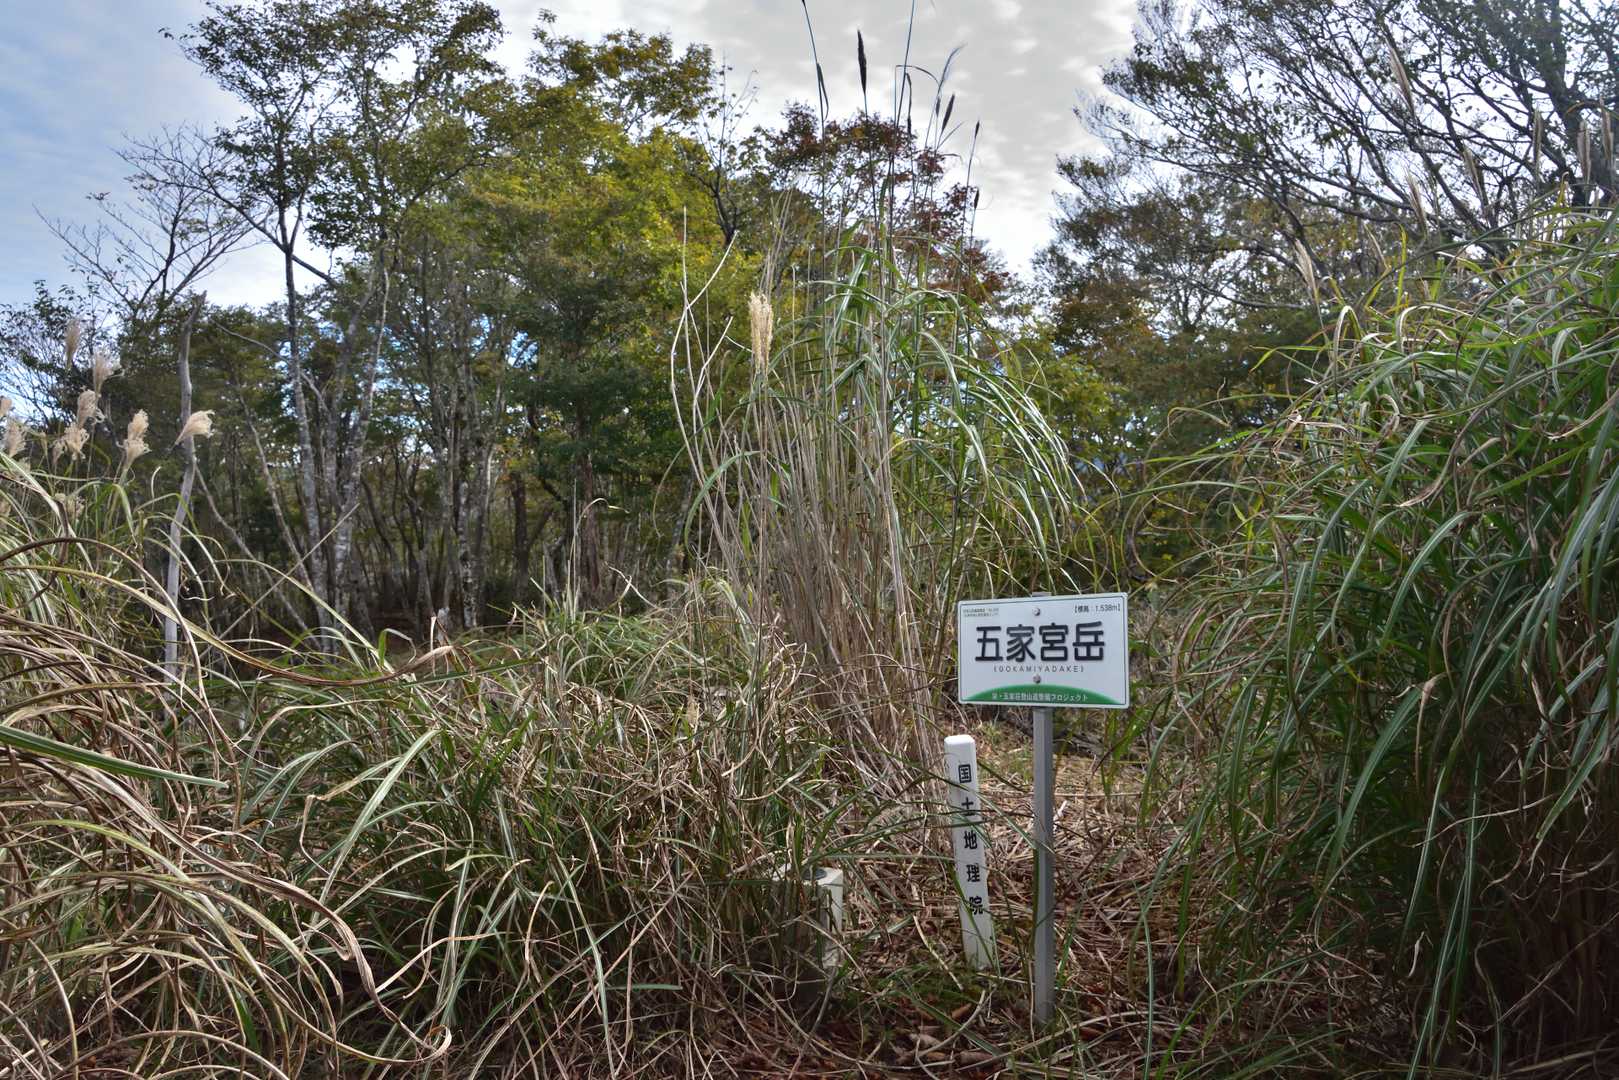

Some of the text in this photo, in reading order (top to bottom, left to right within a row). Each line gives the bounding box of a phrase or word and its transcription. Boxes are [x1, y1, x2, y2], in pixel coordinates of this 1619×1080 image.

[974, 620, 1105, 663] 五家宮岳
[958, 763, 984, 916] 国土地理院
